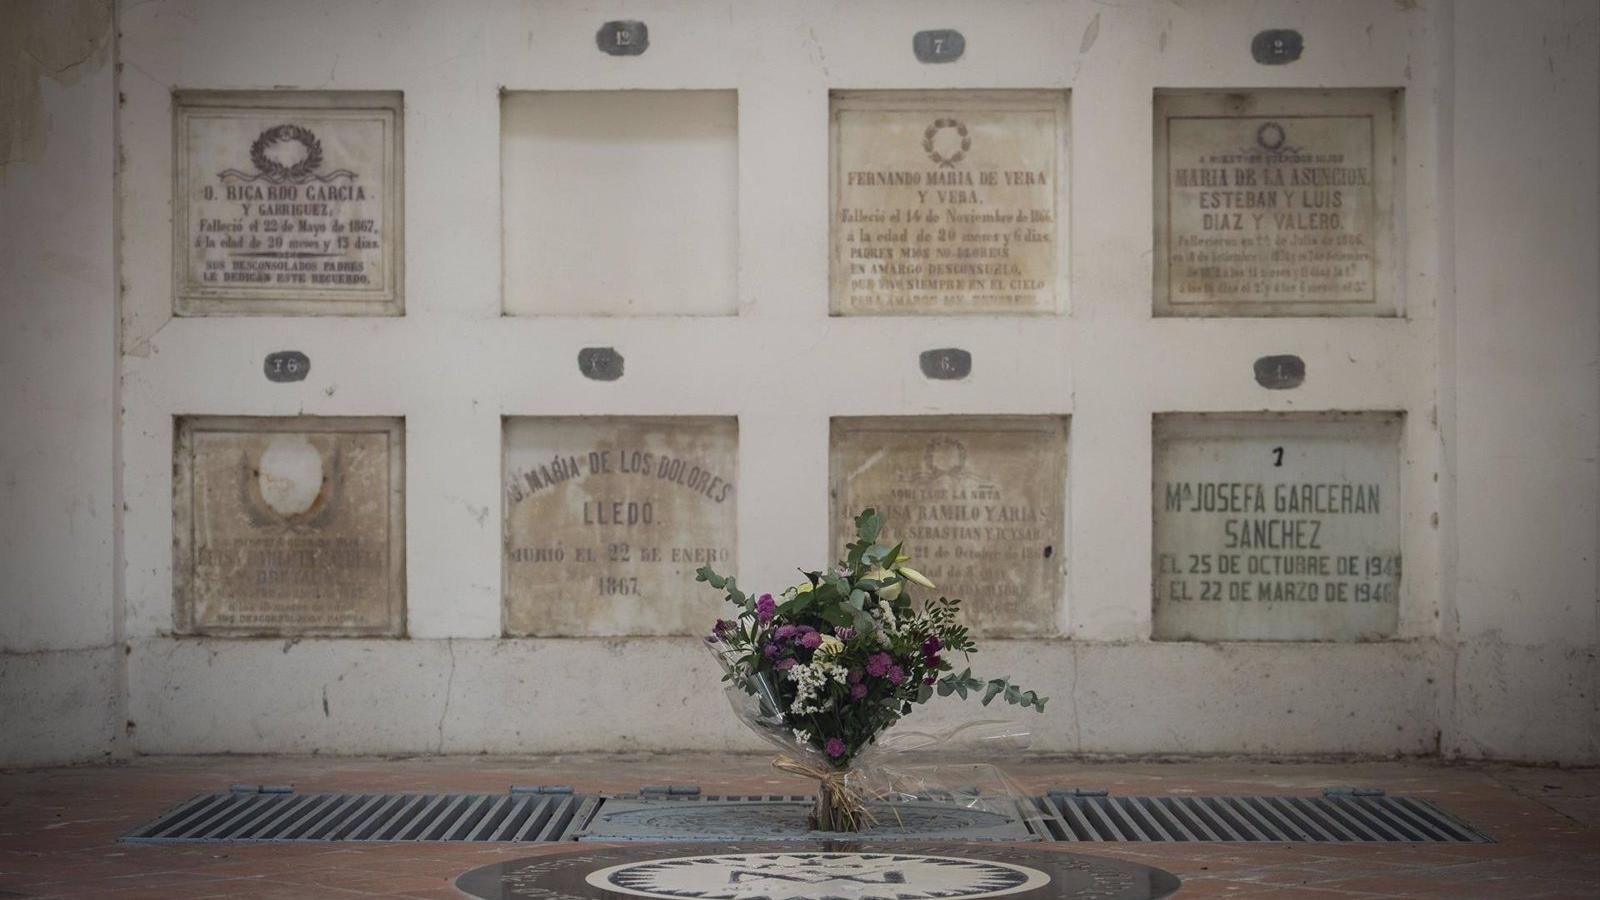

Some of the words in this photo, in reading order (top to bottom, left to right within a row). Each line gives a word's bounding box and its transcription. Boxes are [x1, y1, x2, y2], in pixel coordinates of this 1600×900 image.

[616, 31, 631, 46] 12
[934, 39, 944, 54] 7
[848, 171, 922, 186] FERNANDO
[926, 171, 974, 186] MARIA
[980, 171, 998, 186] DE
[1004, 171, 1047, 186] VERA
[1175, 168, 1229, 187] MARIA
[1235, 168, 1257, 187] DE
[1264, 168, 1284, 187] LA
[226, 185, 298, 201] RICARDO
[918, 190, 928, 205] Y
[1200, 191, 1277, 209] ESTEBAN
[1284, 191, 1295, 209] Y
[1303, 191, 1343, 209] LUIS
[242, 203, 250, 217] Y
[889, 208, 900, 224] el
[906, 208, 922, 224] 14
[925, 208, 940, 224] de
[947, 208, 1013, 224] Noviembre
[1016, 208, 1029, 224] de
[249, 218, 259, 233] el
[263, 218, 278, 233] 22
[281, 218, 294, 233] de
[298, 218, 327, 238] Mayo
[332, 218, 345, 233] de
[1203, 214, 1244, 231] DIAZ
[1252, 214, 1264, 231] Y
[1274, 214, 1345, 231] VALERO.
[206, 235, 216, 249] la
[220, 235, 244, 249] edad
[250, 235, 262, 249] de
[267, 235, 284, 249] 20
[288, 239, 319, 249] meses
[323, 239, 332, 252] y
[860, 228, 872, 242] la
[876, 228, 909, 242] edad
[916, 228, 932, 242] de
[938, 228, 957, 242] 20
[962, 233, 999, 242] meses
[1002, 233, 1010, 247] y
[850, 248, 893, 259] PADRES
[936, 248, 951, 259] NO
[206, 261, 225, 272] SUS
[232, 261, 318, 272] DESCONSOLADOS
[323, 261, 365, 272] PADRES
[850, 264, 866, 275] EN
[870, 264, 923, 275] AMARGO
[203, 272, 218, 284] LE
[224, 272, 271, 284] DEDICAN
[277, 272, 306, 284] ESTE
[907, 279, 965, 291] SIEMPRE
[968, 279, 985, 291] EN
[990, 279, 1007, 291] EL
[1009, 279, 1045, 291] CIELO
[273, 359, 297, 373] 16
[588, 450, 611, 475] DE
[620, 450, 654, 476] LOS
[656, 455, 734, 504] DOLORES
[951, 489, 967, 500] LA
[1191, 482, 1266, 513] JOSEFA
[1274, 483, 1380, 514] GARCERAN
[984, 504, 998, 521] Y
[998, 504, 1048, 521] ARIAS
[909, 527, 982, 540] SEBASTIAN
[1225, 519, 1322, 550] SANCHEZ
[575, 548, 598, 563] EL
[607, 543, 631, 563] 22
[640, 548, 662, 563] DE
[671, 548, 730, 563] ENERO
[1159, 554, 1182, 575] EL
[1189, 554, 1211, 575] 25
[1218, 554, 1241, 575] DE
[1247, 554, 1331, 575] OCTUBRE
[1337, 554, 1359, 575] DE
[1170, 581, 1193, 602] EL
[1200, 581, 1222, 602] 22
[1229, 581, 1251, 602] DE
[1258, 581, 1319, 602] MARZO
[1325, 581, 1348, 602] DE
